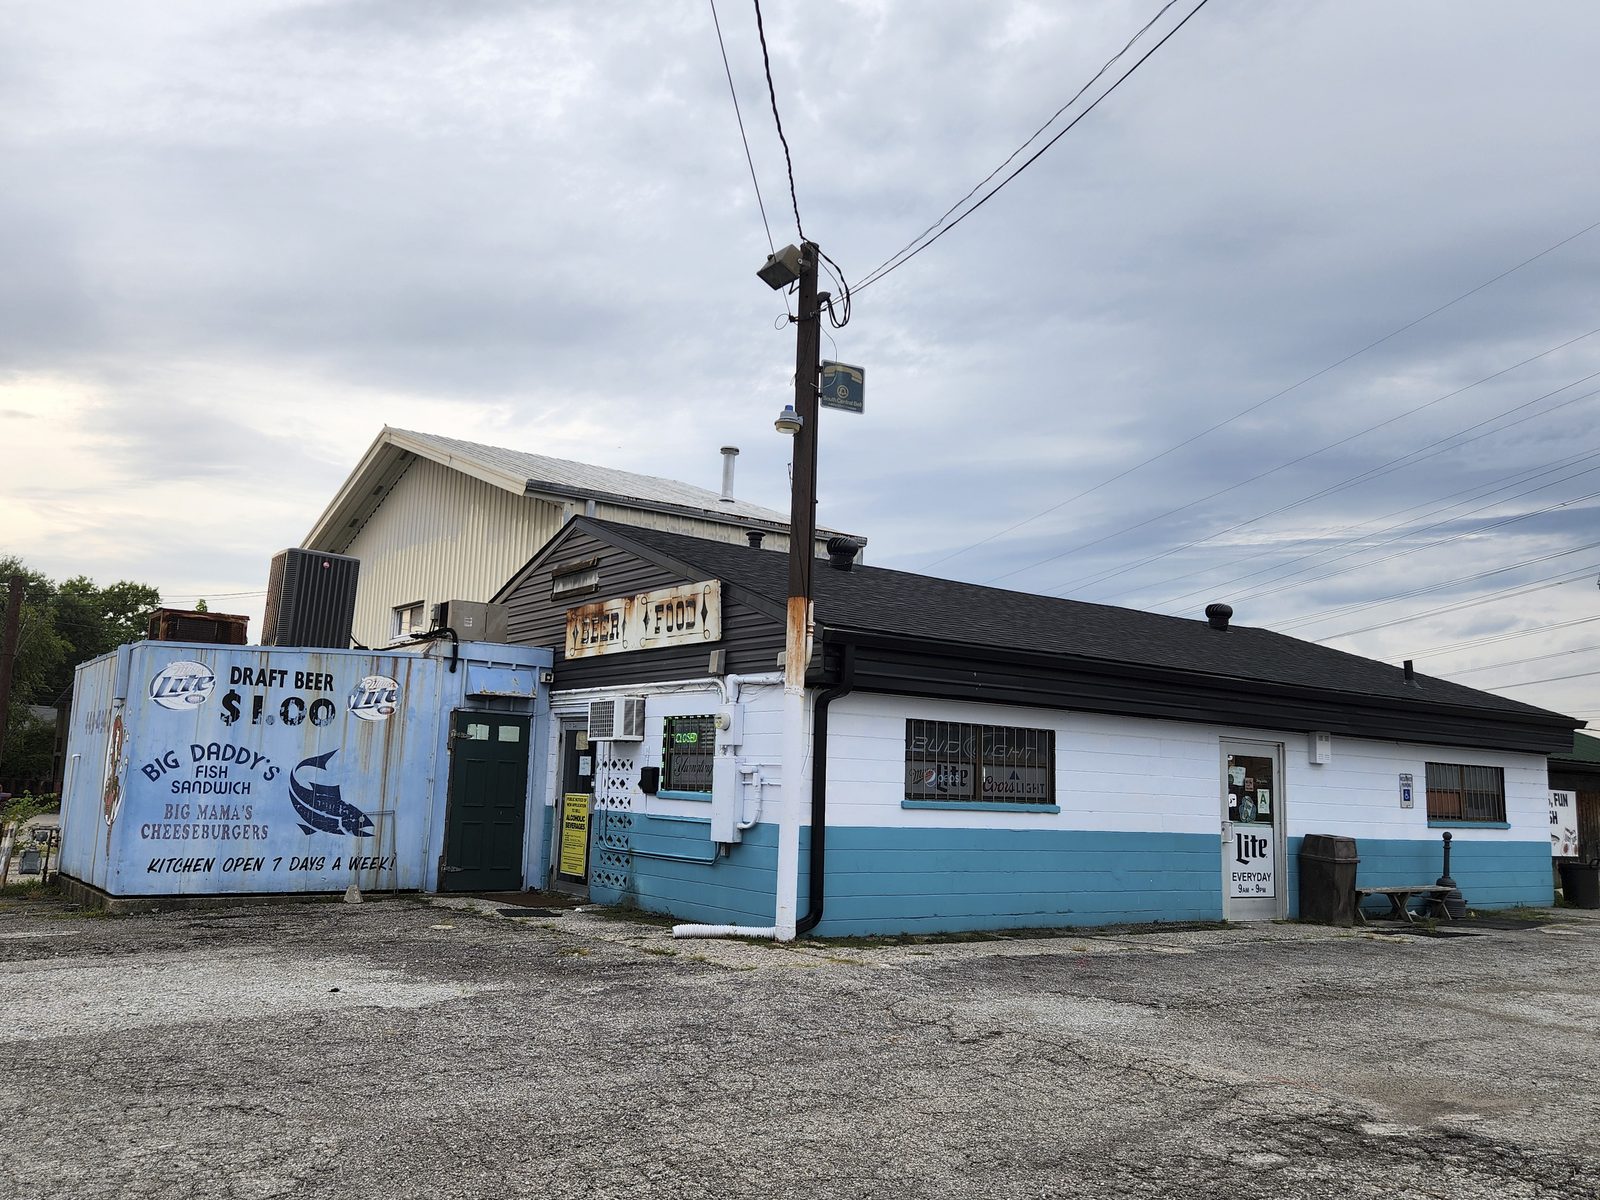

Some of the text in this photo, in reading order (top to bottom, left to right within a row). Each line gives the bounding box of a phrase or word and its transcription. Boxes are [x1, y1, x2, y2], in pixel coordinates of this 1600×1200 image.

[581, 600, 696, 644] BEER FOOD
[153, 674, 215, 698] Lite
[230, 666, 334, 691] DRAFT BEER
[220, 689, 336, 727] $1.00
[675, 732, 698, 743] CLOSED
[909, 736, 961, 753] BUD
[141, 742, 281, 782] BIG DADDY'S
[195, 765, 228, 778] FISH
[171, 780, 251, 794] SANDWICH
[983, 775, 1045, 794] Coors LIGHT
[1260, 793, 1267, 805] A
[1553, 793, 1568, 807] FUN
[163, 803, 253, 820] BIG MAMA'S
[140, 823, 269, 840] CHEESEBURGERS
[1235, 833, 1267, 865] Lite
[147, 856, 397, 873] KITCHEN OPEN 7 DAYS A WEEK!
[1232, 872, 1272, 882] EVERYDAY
[1238, 884, 1250, 893] 9AM
